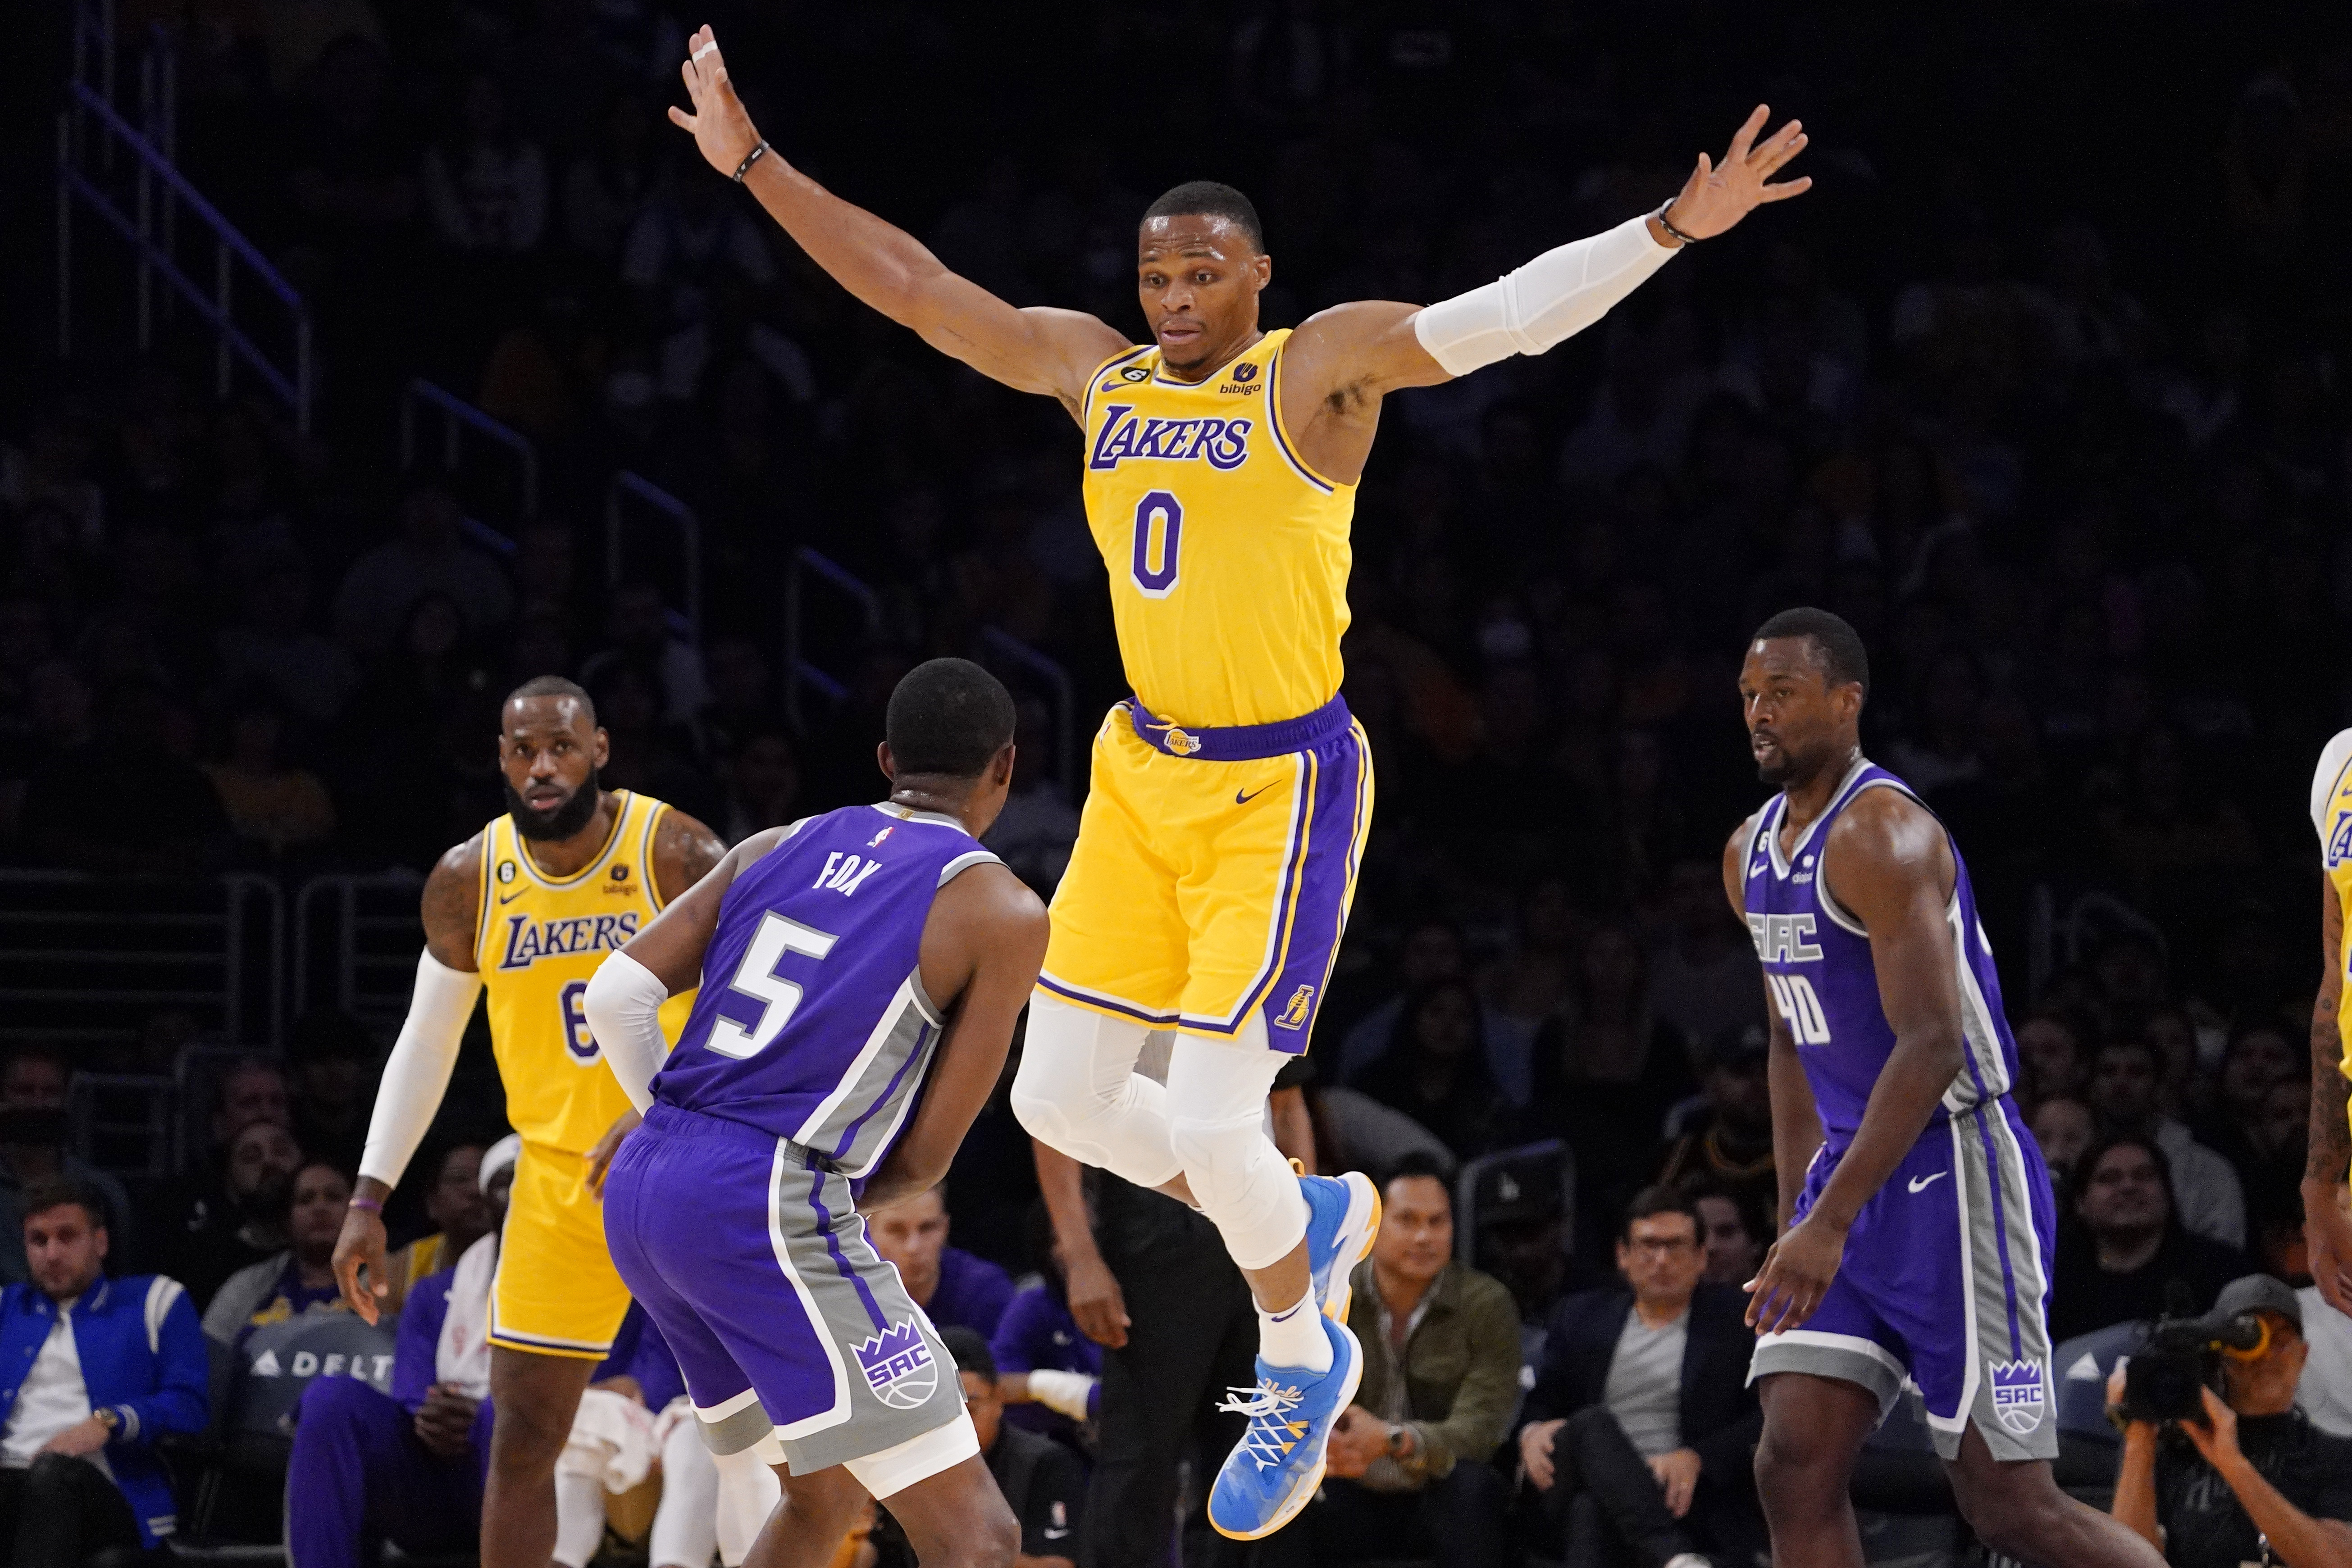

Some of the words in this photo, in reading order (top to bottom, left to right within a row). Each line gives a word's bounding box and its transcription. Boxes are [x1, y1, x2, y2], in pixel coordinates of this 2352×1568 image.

[1125, 369, 1147, 381] 6
[1220, 383, 1262, 396] bibigo
[1089, 404, 1254, 471] LAKERS
[1130, 489, 1184, 600] 0
[1166, 734, 1200, 750] LAKERS
[2327, 809, 2352, 868] LA
[812, 851, 883, 897] FOX
[498, 912, 639, 973] LAKERS
[703, 909, 840, 1060] 5
[1766, 974, 1832, 1045] 40
[866, 1345, 932, 1389] SAC
[1995, 1387, 2042, 1404] SAC
